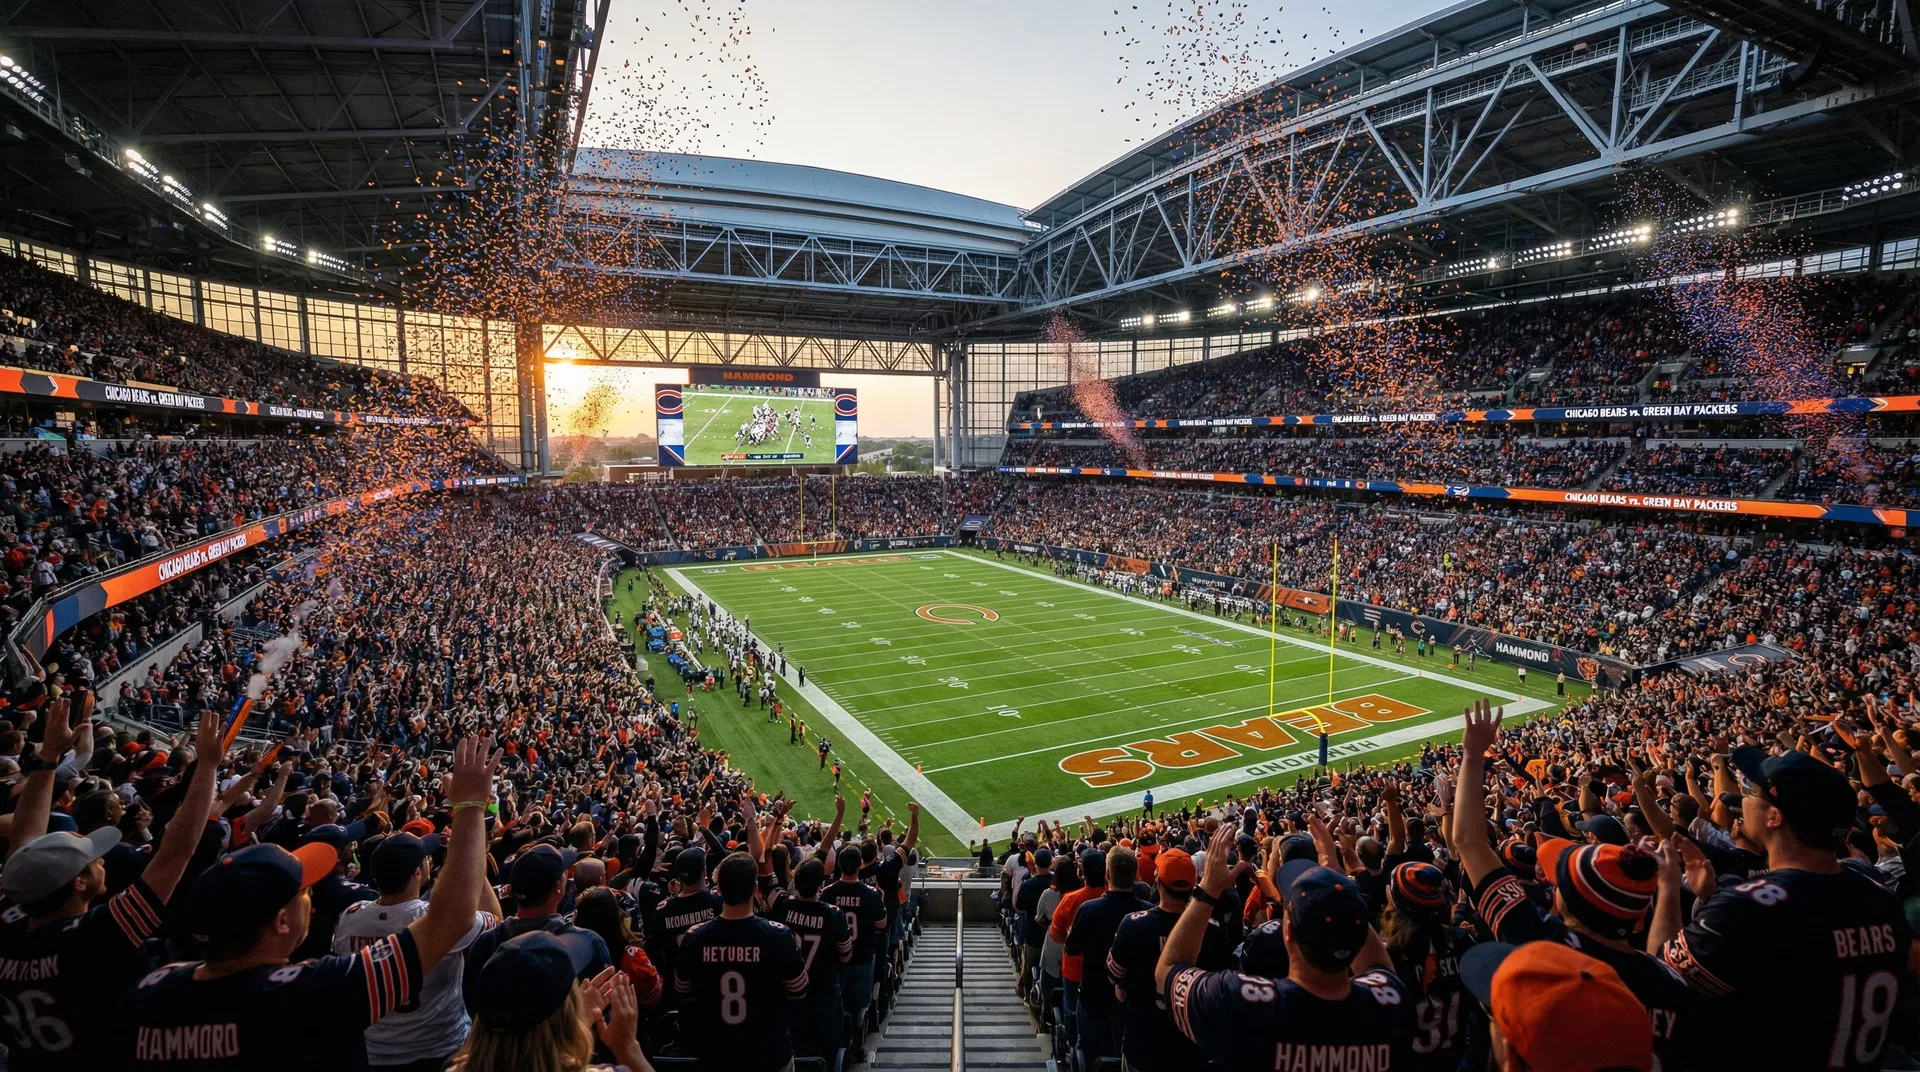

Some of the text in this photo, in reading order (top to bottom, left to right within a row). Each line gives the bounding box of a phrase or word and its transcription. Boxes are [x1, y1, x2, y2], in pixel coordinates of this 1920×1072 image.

[723, 371, 793, 382] HAMMOND
[1565, 407, 1599, 418] CHICAGO
[1600, 407, 1627, 417] BEARS
[1643, 406, 1672, 416] GREEN
[1673, 405, 1692, 416] BAY
[1693, 404, 1738, 415] PACKERS
[1565, 492, 1598, 502] CHICAGO
[1673, 498, 1692, 509] BAY
[1693, 499, 1738, 511] PACKERS
[1496, 641, 1549, 663] HAMMOND
[1058, 693, 1434, 788] BEARS
[1245, 740, 1380, 776] HAMMOND
[1832, 923, 1897, 960] BEARS
[718, 969, 748, 1026] 8
[1645, 1007, 1677, 1041] EY
[1827, 969, 1900, 1070] 18
[1273, 1040, 1392, 1072] HAMMOND
